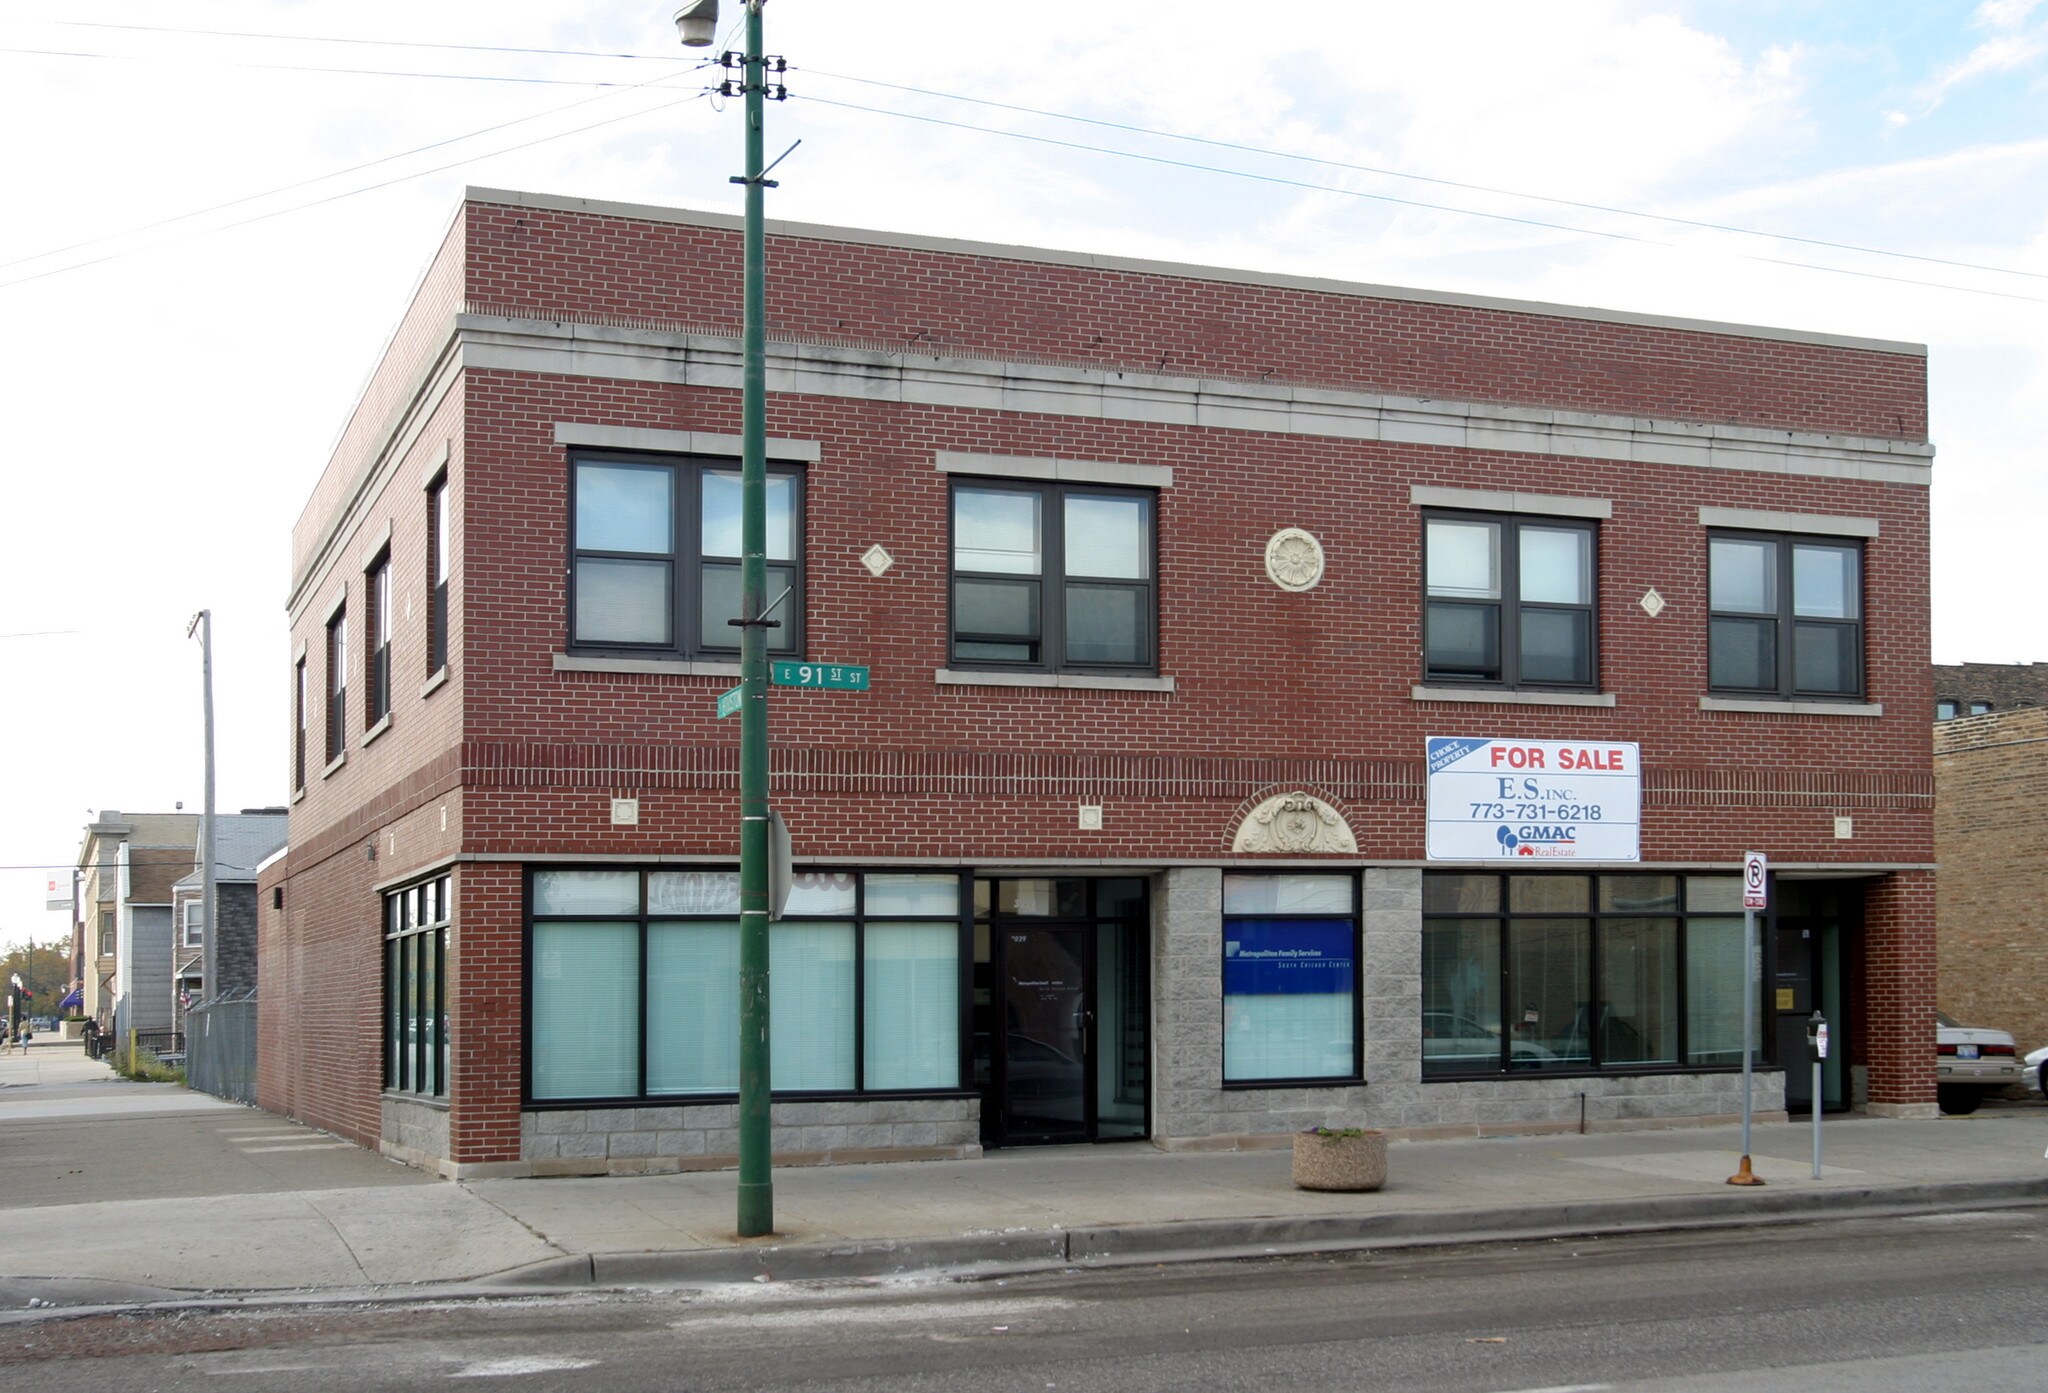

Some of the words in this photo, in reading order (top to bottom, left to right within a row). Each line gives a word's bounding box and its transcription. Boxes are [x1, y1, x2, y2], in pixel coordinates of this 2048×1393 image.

[784, 668, 791, 680] E
[799, 666, 822, 685] 91
[830, 667, 842, 681] ST
[850, 672, 862, 684] ST
[1430, 740, 1460, 760] CHOICE
[1430, 745, 1470, 771] PROPERTY
[1490, 747, 1546, 769] FOR
[1558, 748, 1624, 770] SALE
[1469, 803, 1602, 821] 773-731-6218
[1519, 826, 1576, 840] GMAC
[1238, 950, 1278, 959] Metropolitan
[1278, 949, 1298, 959] Family
[1298, 949, 1322, 957] Services
